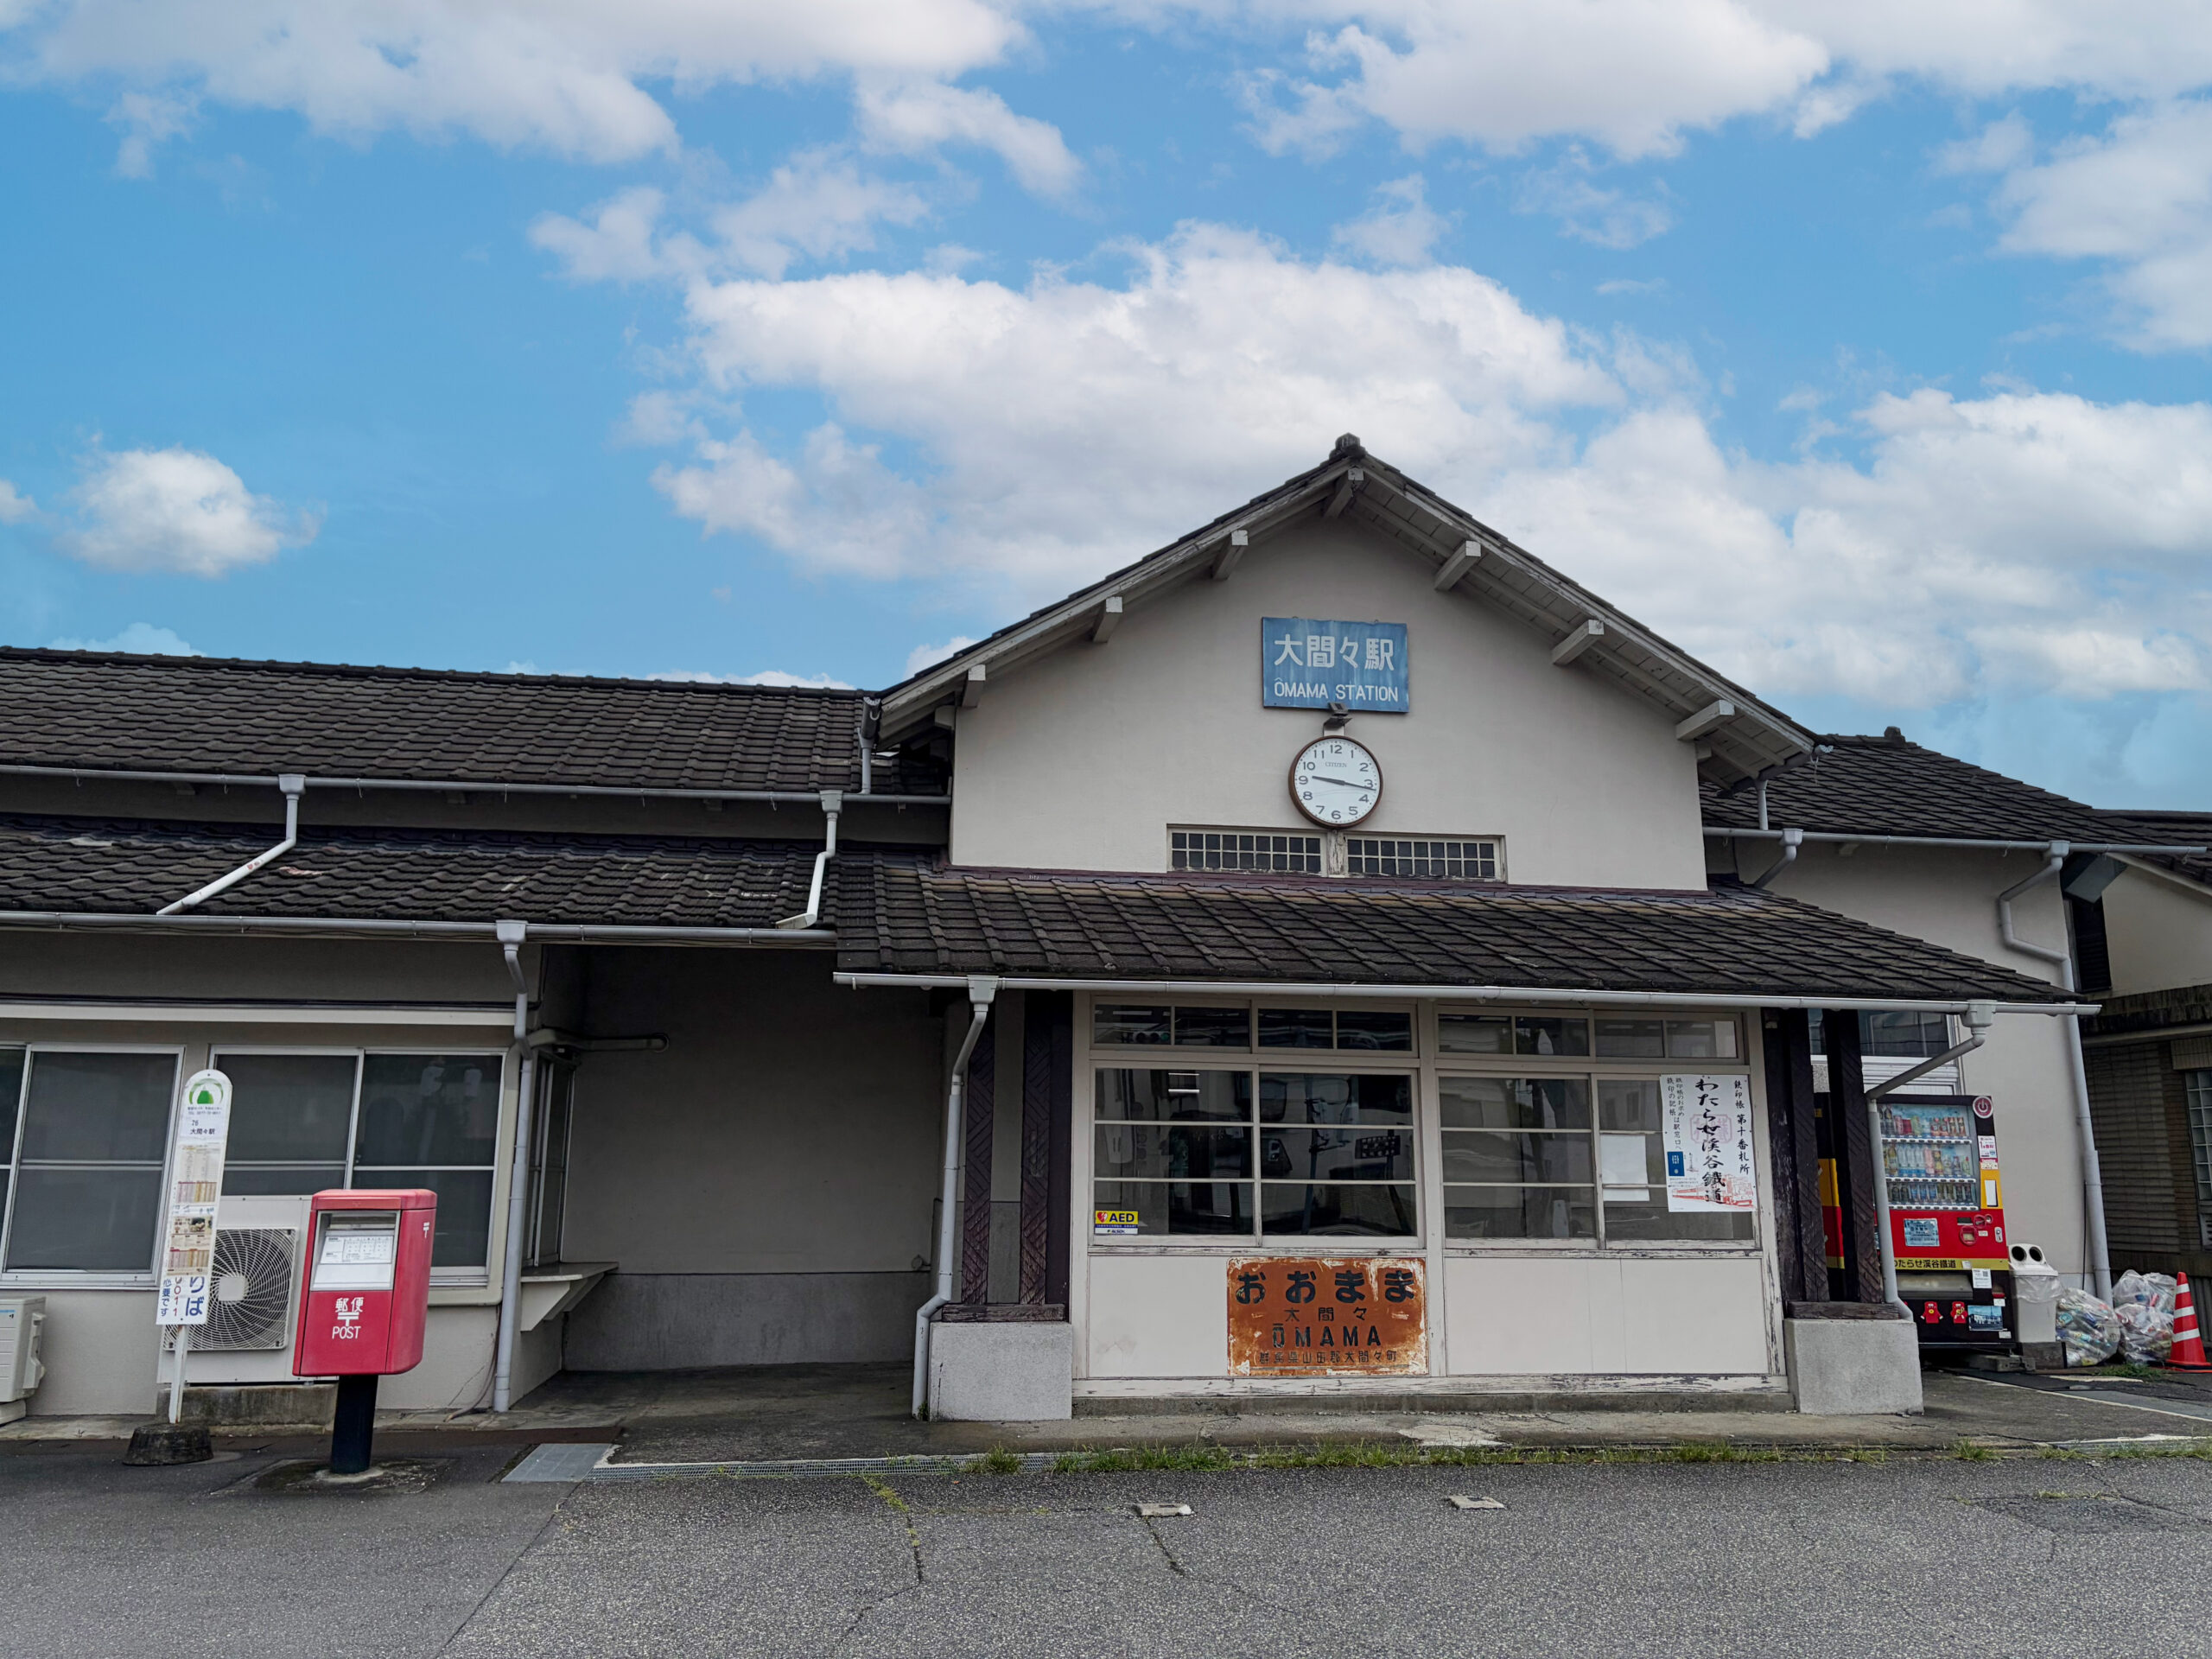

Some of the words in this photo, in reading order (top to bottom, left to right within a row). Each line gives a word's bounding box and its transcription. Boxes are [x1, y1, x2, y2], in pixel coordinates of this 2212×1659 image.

[1274, 634, 1395, 671] 大間々駅
[1335, 684, 1399, 702] STATION
[1313, 749, 1325, 759] 11
[1330, 745, 1343, 754] 12
[1351, 749, 1354, 759] 1
[1303, 761, 1316, 771] 10
[1359, 762, 1369, 772] 2
[1298, 775, 1309, 785] 9
[1363, 779, 1374, 788] 3
[1302, 791, 1313, 801] 8
[1358, 794, 1370, 804] 4
[1315, 804, 1325, 815] 7
[1348, 806, 1358, 816] 5
[1331, 810, 1342, 820] 6
[1109, 1212, 1135, 1223] AED
[1236, 1270, 1414, 1304] おおまま
[334, 1297, 364, 1313] 郵便
[1285, 1306, 1367, 1322] 大間々
[332, 1325, 361, 1339] POST
